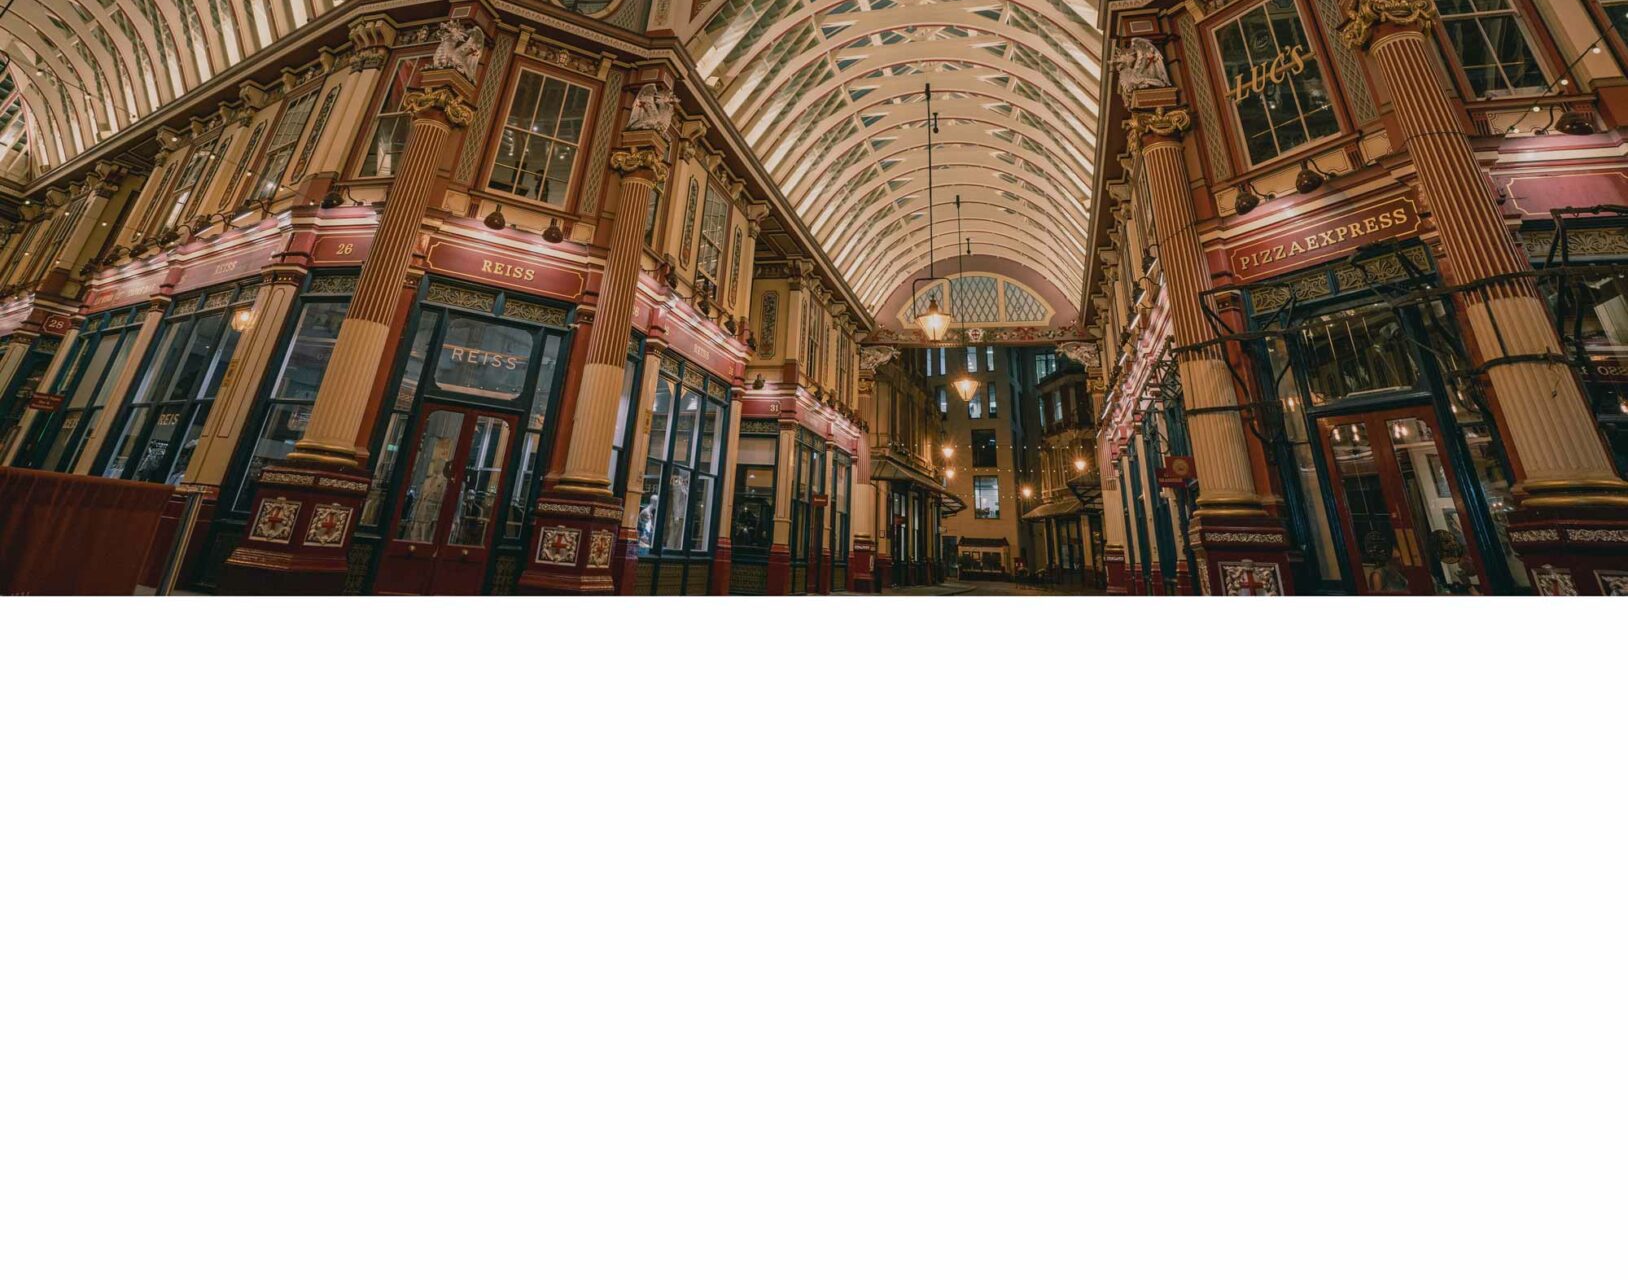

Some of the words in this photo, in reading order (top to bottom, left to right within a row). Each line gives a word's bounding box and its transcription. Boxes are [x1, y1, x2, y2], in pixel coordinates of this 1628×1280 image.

[1234, 44, 1304, 104] LUC'S
[336, 243, 354, 256] 26
[1240, 207, 1408, 270] PIZZAEXPRESS
[482, 259, 535, 281] REISS
[451, 347, 518, 370] REISS
